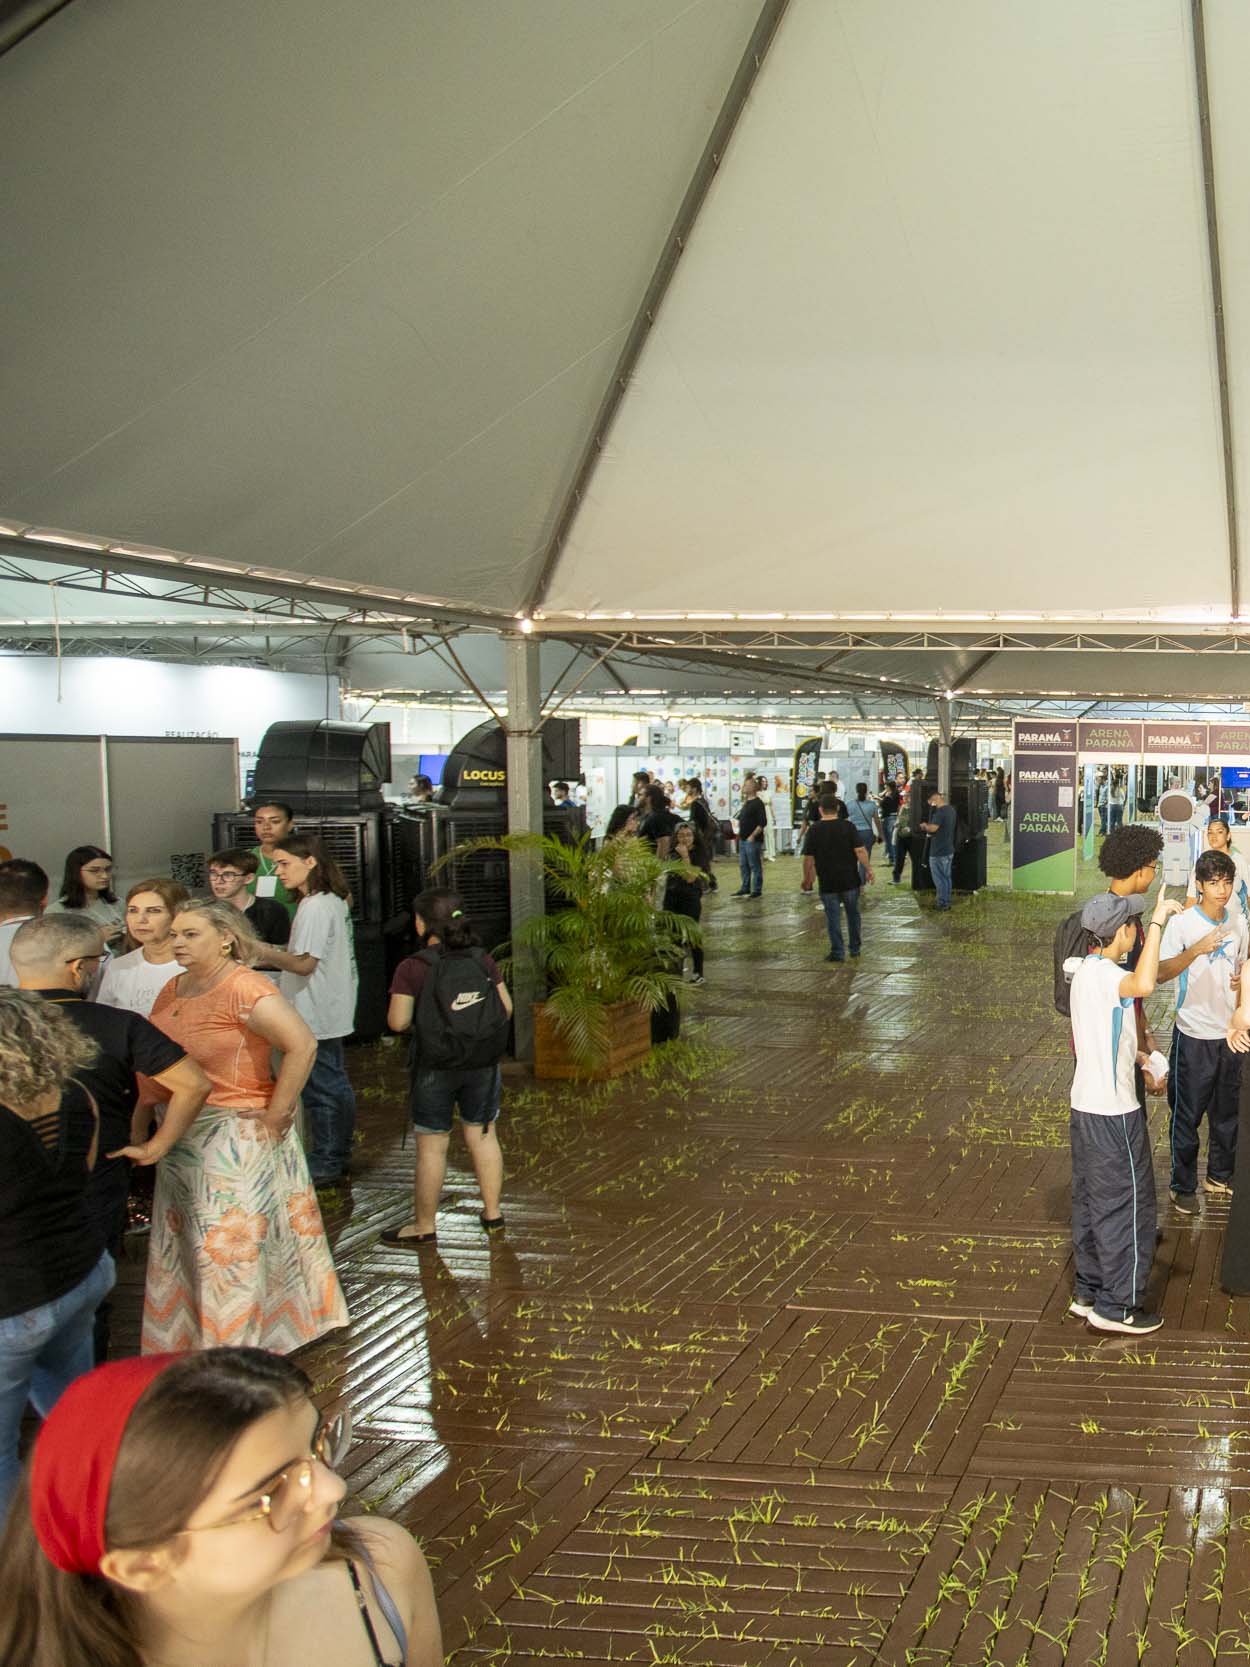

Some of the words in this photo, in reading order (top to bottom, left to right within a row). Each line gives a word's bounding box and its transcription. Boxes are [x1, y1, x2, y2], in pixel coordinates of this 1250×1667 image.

[1018, 732, 1061, 742] PARANÁ
[1089, 729, 1130, 738] ARENA
[1147, 735, 1192, 744] PARANÁ
[463, 769, 506, 780] LOCUS
[1018, 770, 1060, 780] PARANÁ
[1023, 812, 1065, 822] ARENA
[1019, 822, 1070, 833] PARANÁ
